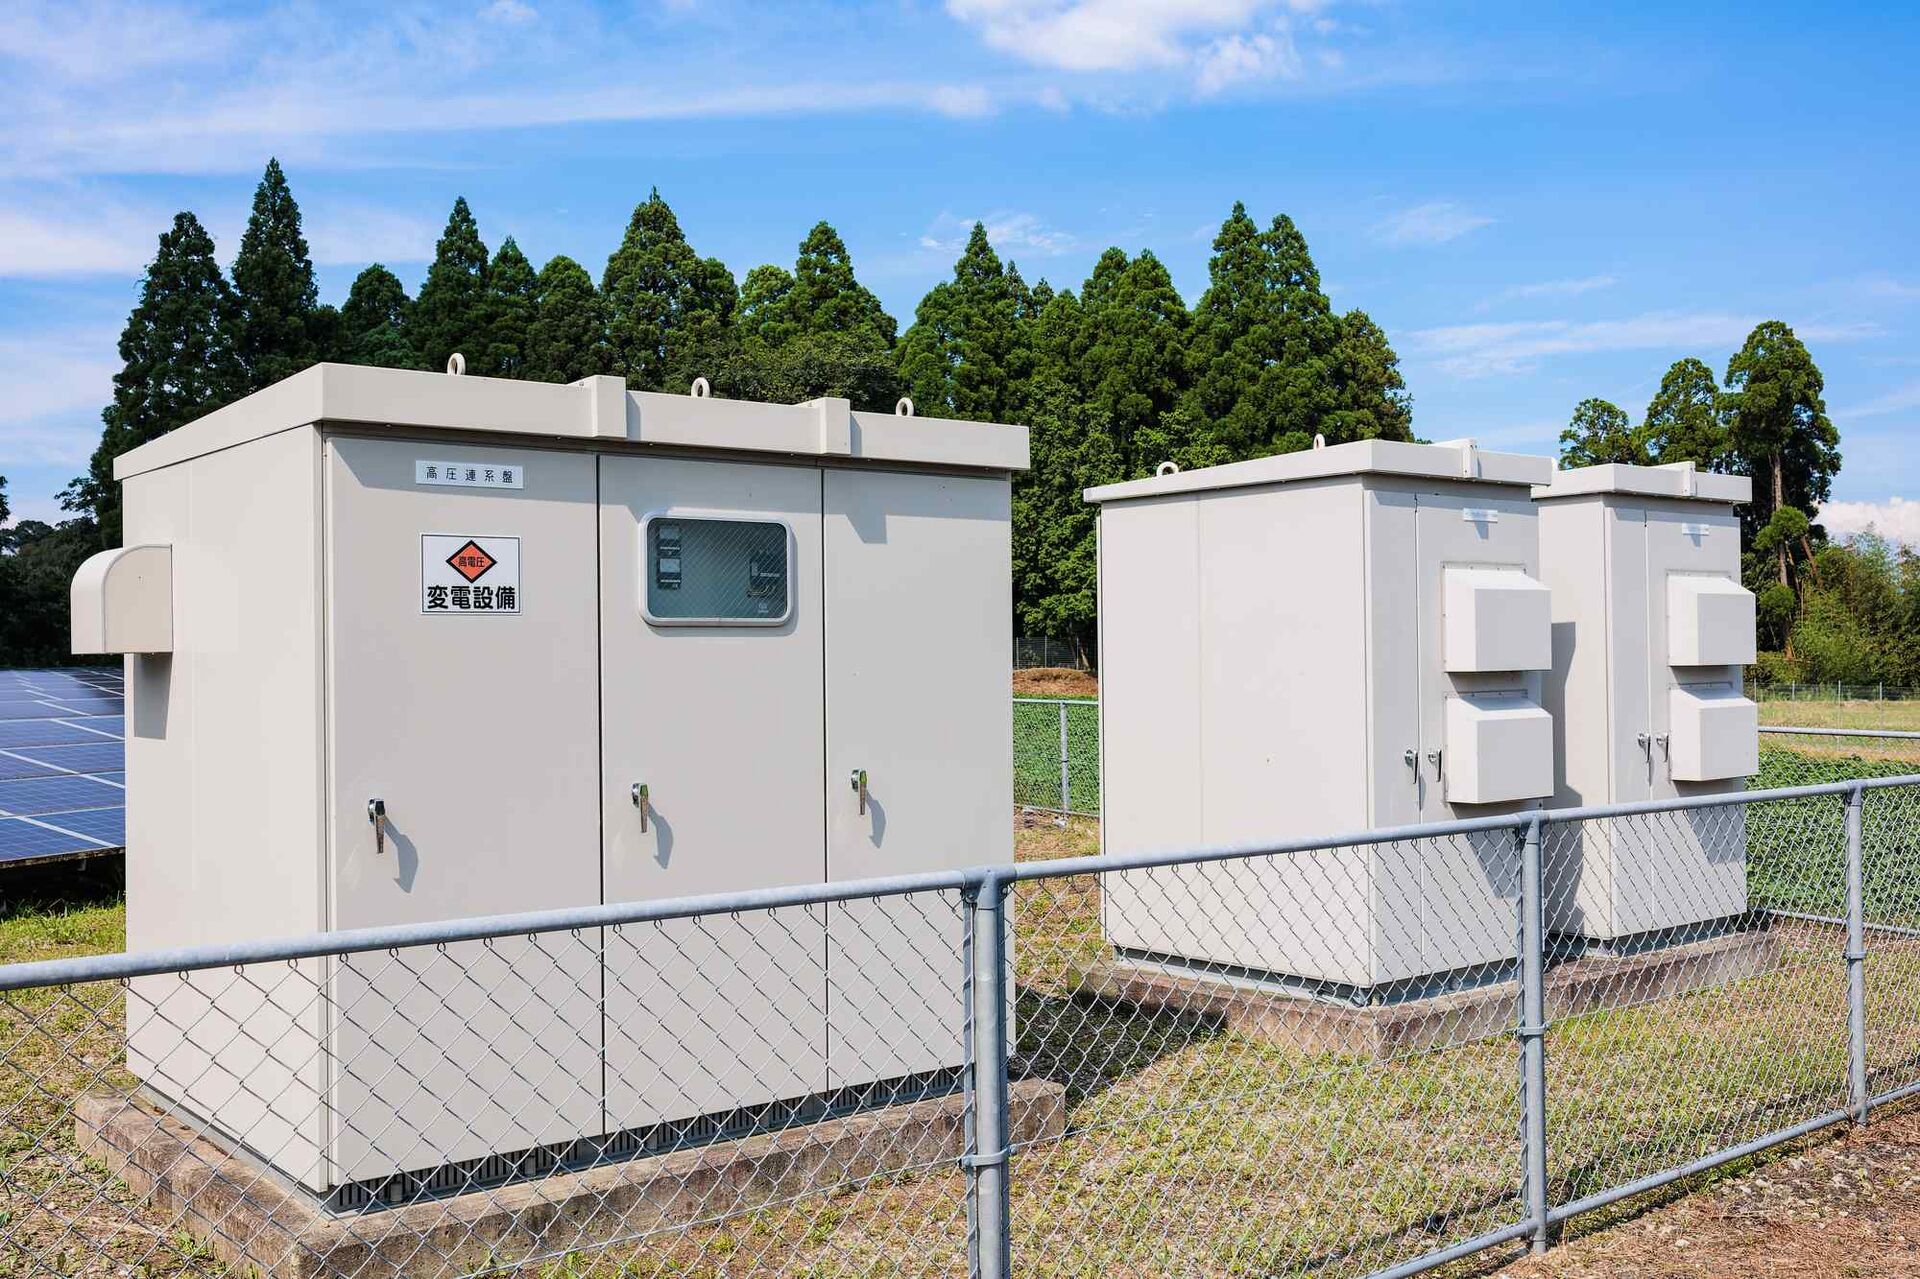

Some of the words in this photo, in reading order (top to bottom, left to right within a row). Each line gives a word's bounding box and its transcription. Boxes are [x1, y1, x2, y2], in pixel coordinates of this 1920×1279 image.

[426, 466, 513, 484] 高圧連系盤
[458, 556, 486, 568] 高電圧
[427, 585, 516, 610] 変電設備
